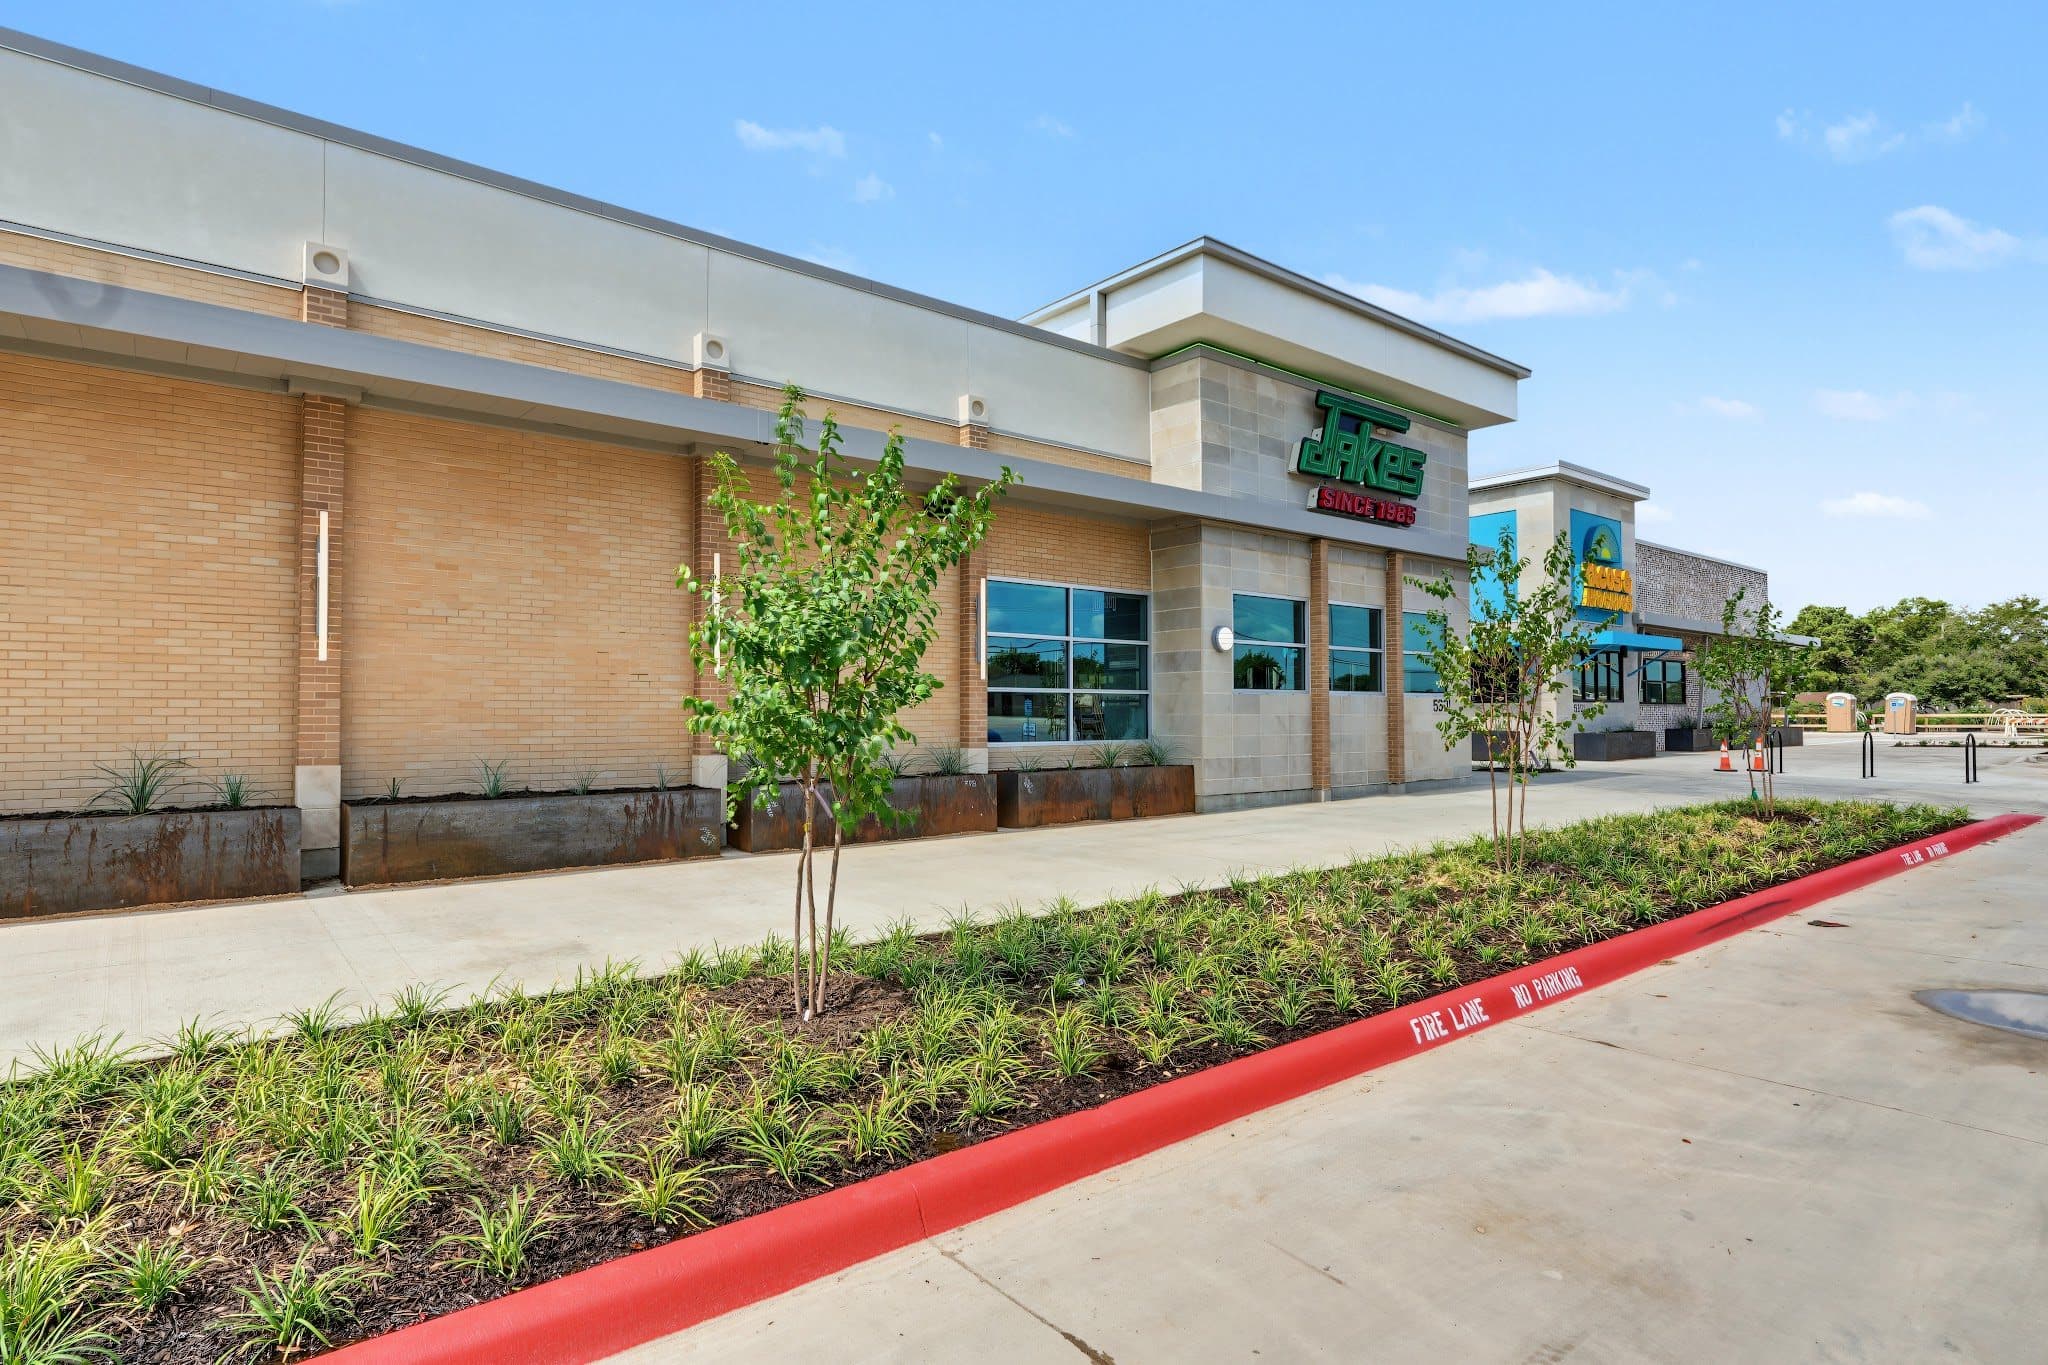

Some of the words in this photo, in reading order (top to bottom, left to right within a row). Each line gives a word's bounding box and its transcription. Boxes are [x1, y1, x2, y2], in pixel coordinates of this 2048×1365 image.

[1318, 487, 1376, 517] SINCE
[1377, 500, 1417, 526] 1985
[1409, 1011, 1449, 1044] FIRE
[1447, 997, 1490, 1031] LANE
[1510, 983, 1533, 1009] NO
[1532, 966, 1583, 1001] PARKING
